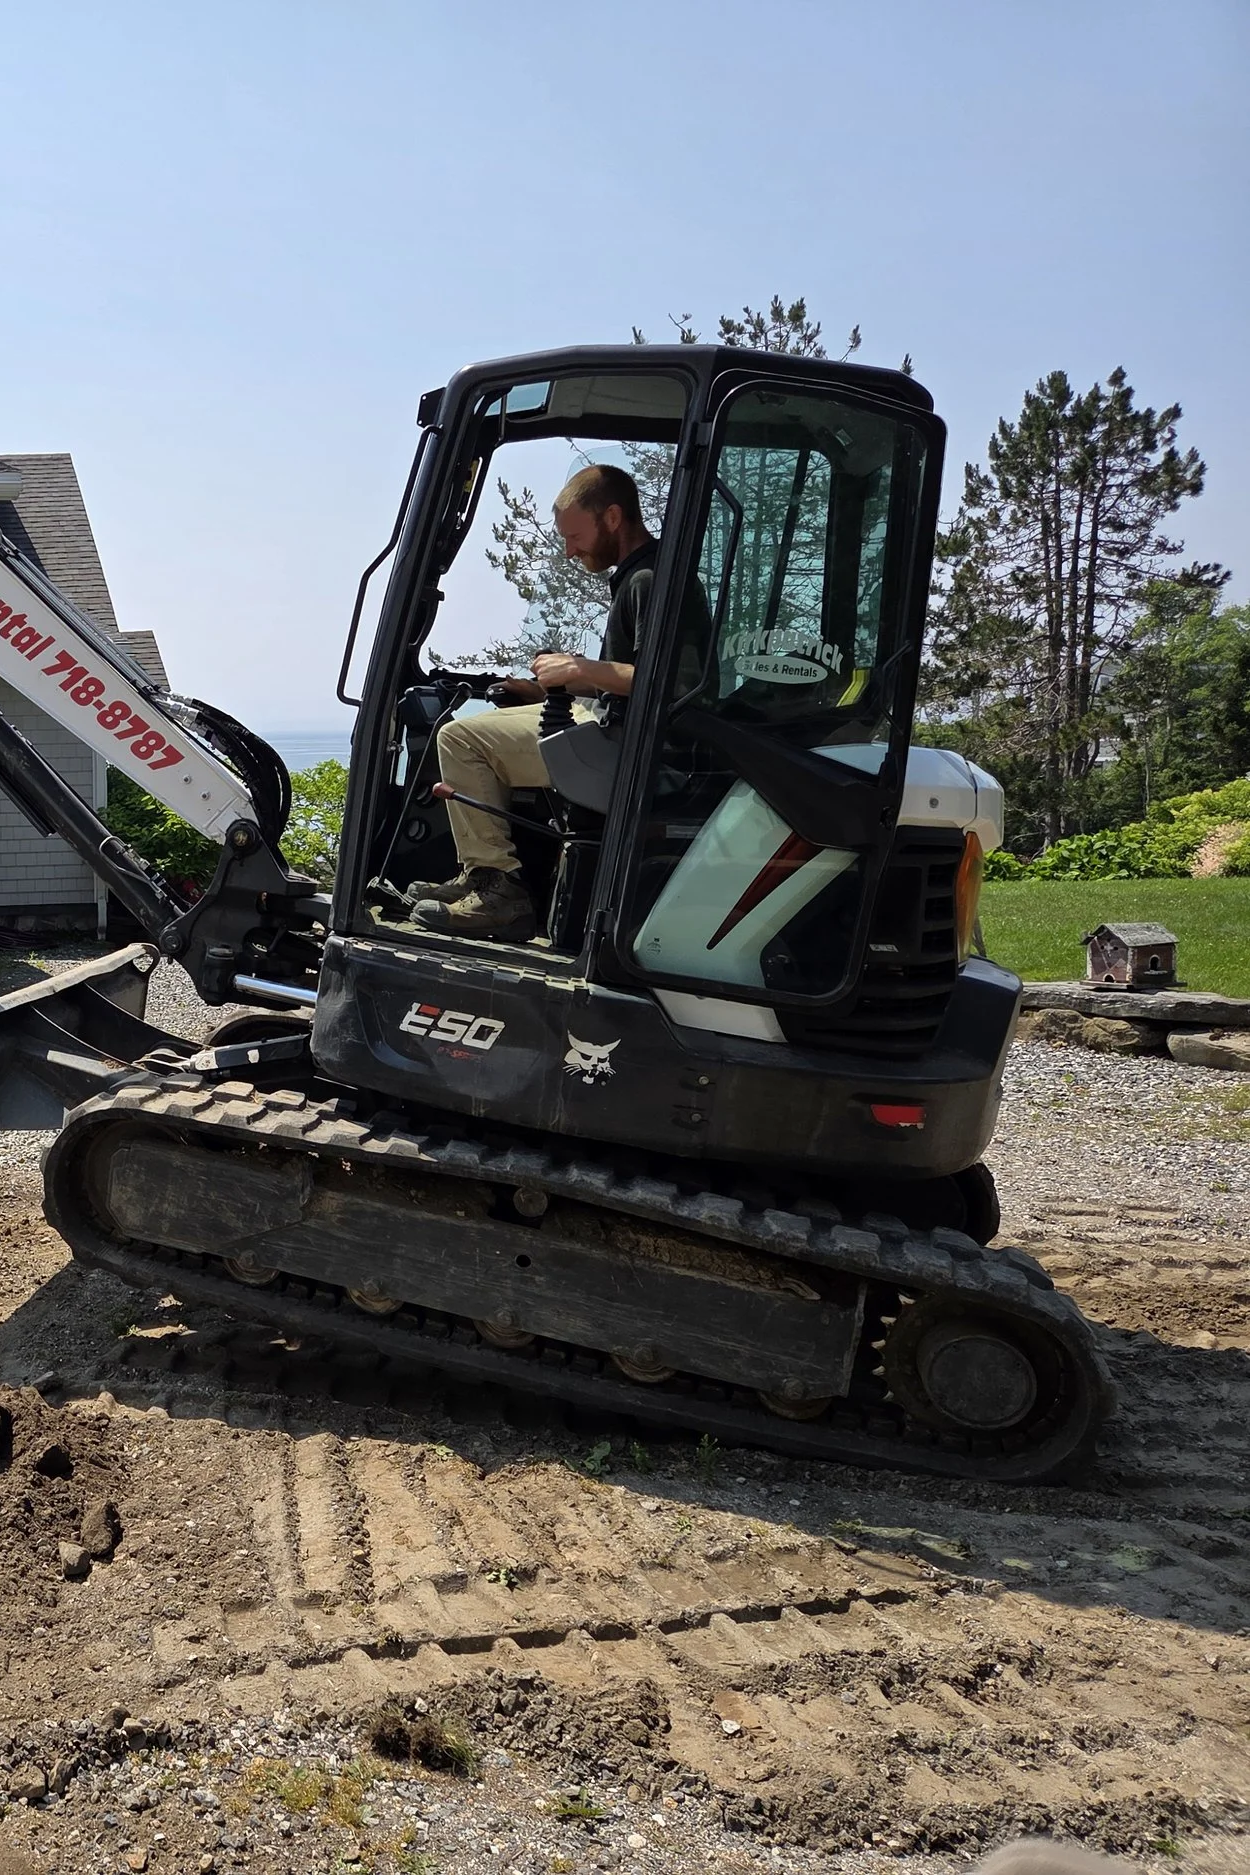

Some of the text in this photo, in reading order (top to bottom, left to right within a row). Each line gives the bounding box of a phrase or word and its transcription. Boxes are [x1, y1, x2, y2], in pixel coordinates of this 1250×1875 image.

[721, 627, 844, 675] Kirkpatrick
[772, 663, 779, 674] &
[781, 664, 818, 678] Rentals
[41, 649, 185, 771] 718-8787
[399, 1002, 506, 1050] E50
